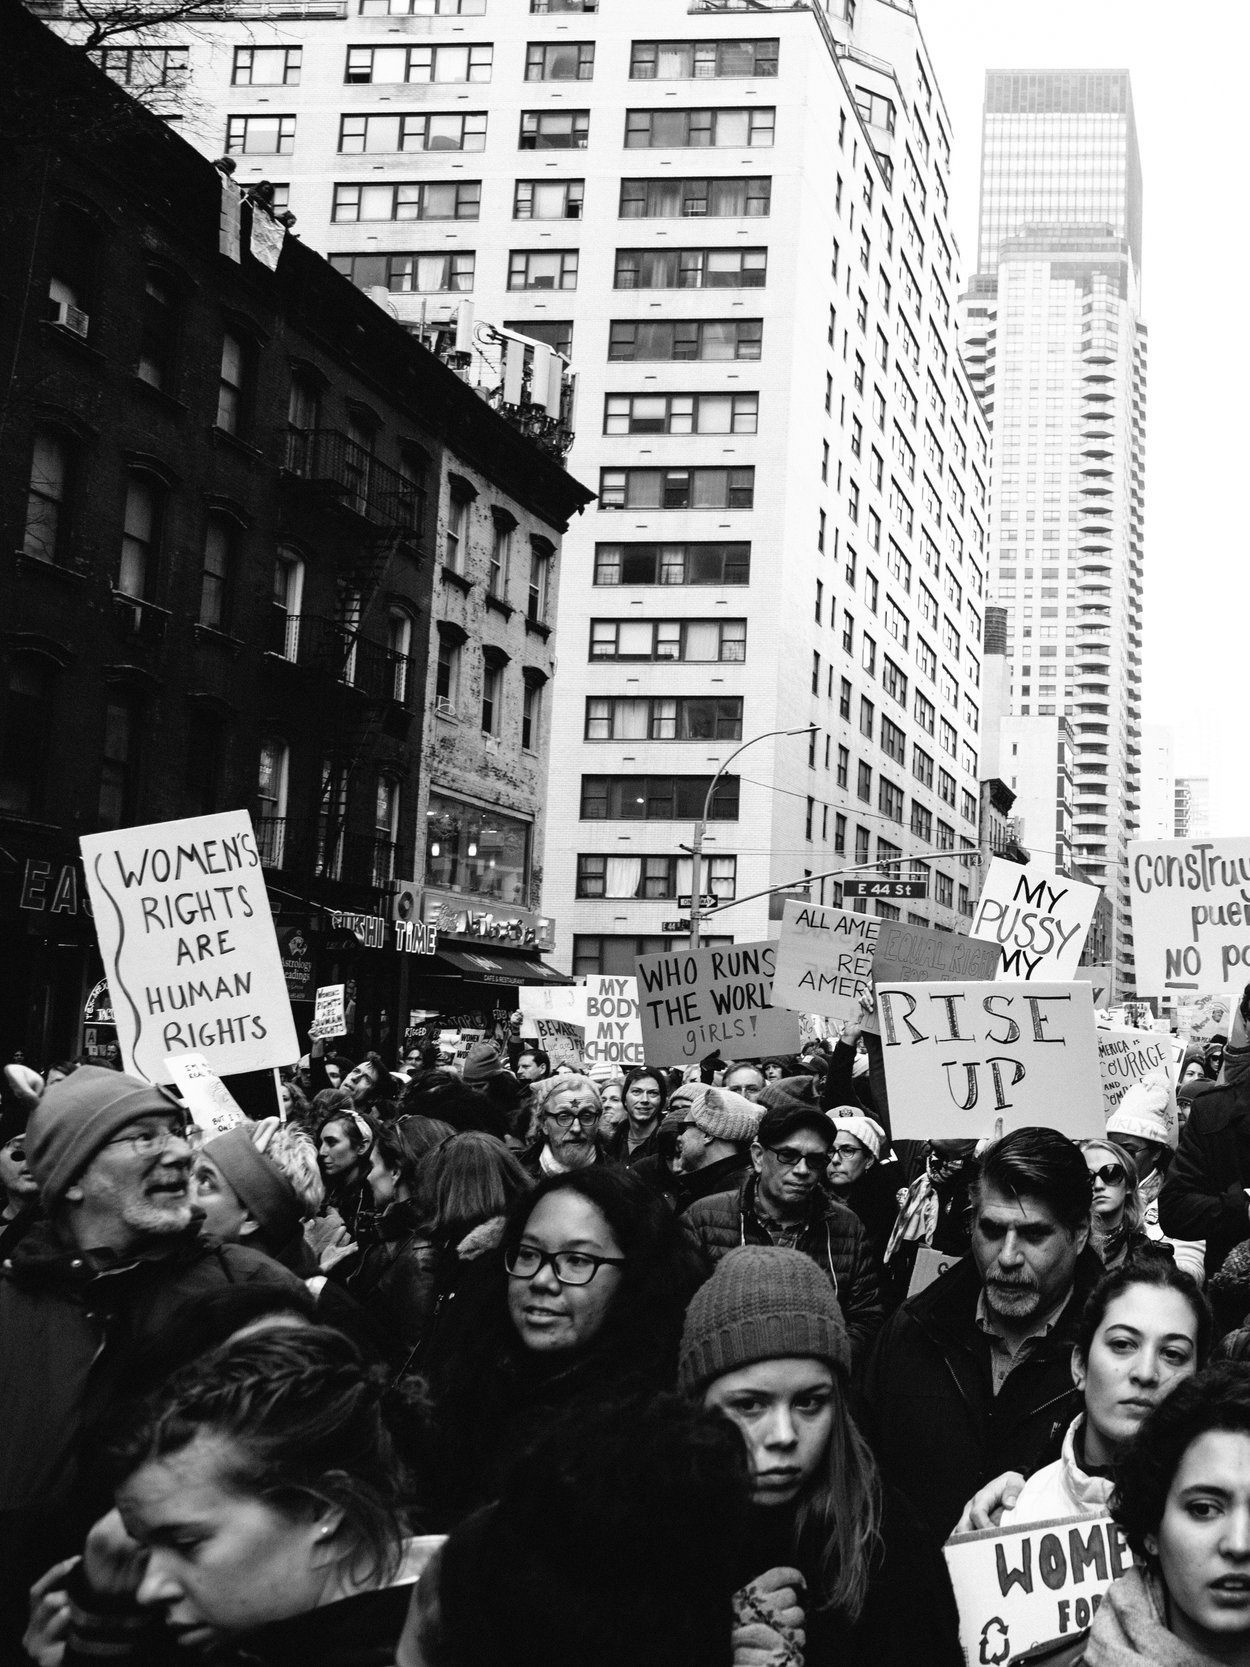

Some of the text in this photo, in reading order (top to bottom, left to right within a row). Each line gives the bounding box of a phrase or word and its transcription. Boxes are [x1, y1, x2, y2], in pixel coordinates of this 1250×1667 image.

[114, 833, 258, 888] WOMEN'S
[20, 858, 94, 917] EA
[683, 899, 694, 907] ON
[858, 883, 911, 896] E 44 St
[1012, 874, 1069, 914] MY
[141, 885, 253, 933] RIGHTS
[795, 909, 881, 941] ALL AME
[395, 920, 437, 955] TIME
[974, 897, 1082, 960] PUSSY
[176, 930, 236, 966] ARE
[853, 942, 876, 956] AR
[883, 929, 945, 971] EQUAL
[1000, 945, 1043, 981] MY
[1165, 947, 1201, 980] NO
[284, 970, 311, 984] eadings
[599, 979, 629, 997] MY
[639, 948, 775, 993] WHO RUNS
[798, 970, 868, 999] AMER
[145, 972, 252, 1015] HUMAN
[587, 996, 639, 1018] BODY
[646, 981, 776, 1029] THE WORL
[163, 1015, 267, 1051] RIGHTS
[597, 1021, 629, 1040] MY
[683, 1014, 757, 1057] giRLS!
[879, 989, 1071, 1047] RISE
[461, 1033, 480, 1043] WOMEN
[585, 1041, 644, 1062] CHOICE
[1097, 1039, 1129, 1059] MERICA
[941, 1056, 1026, 1111] UP
[1103, 1080, 1121, 1090] AND
[994, 1521, 1135, 1598] WOME
